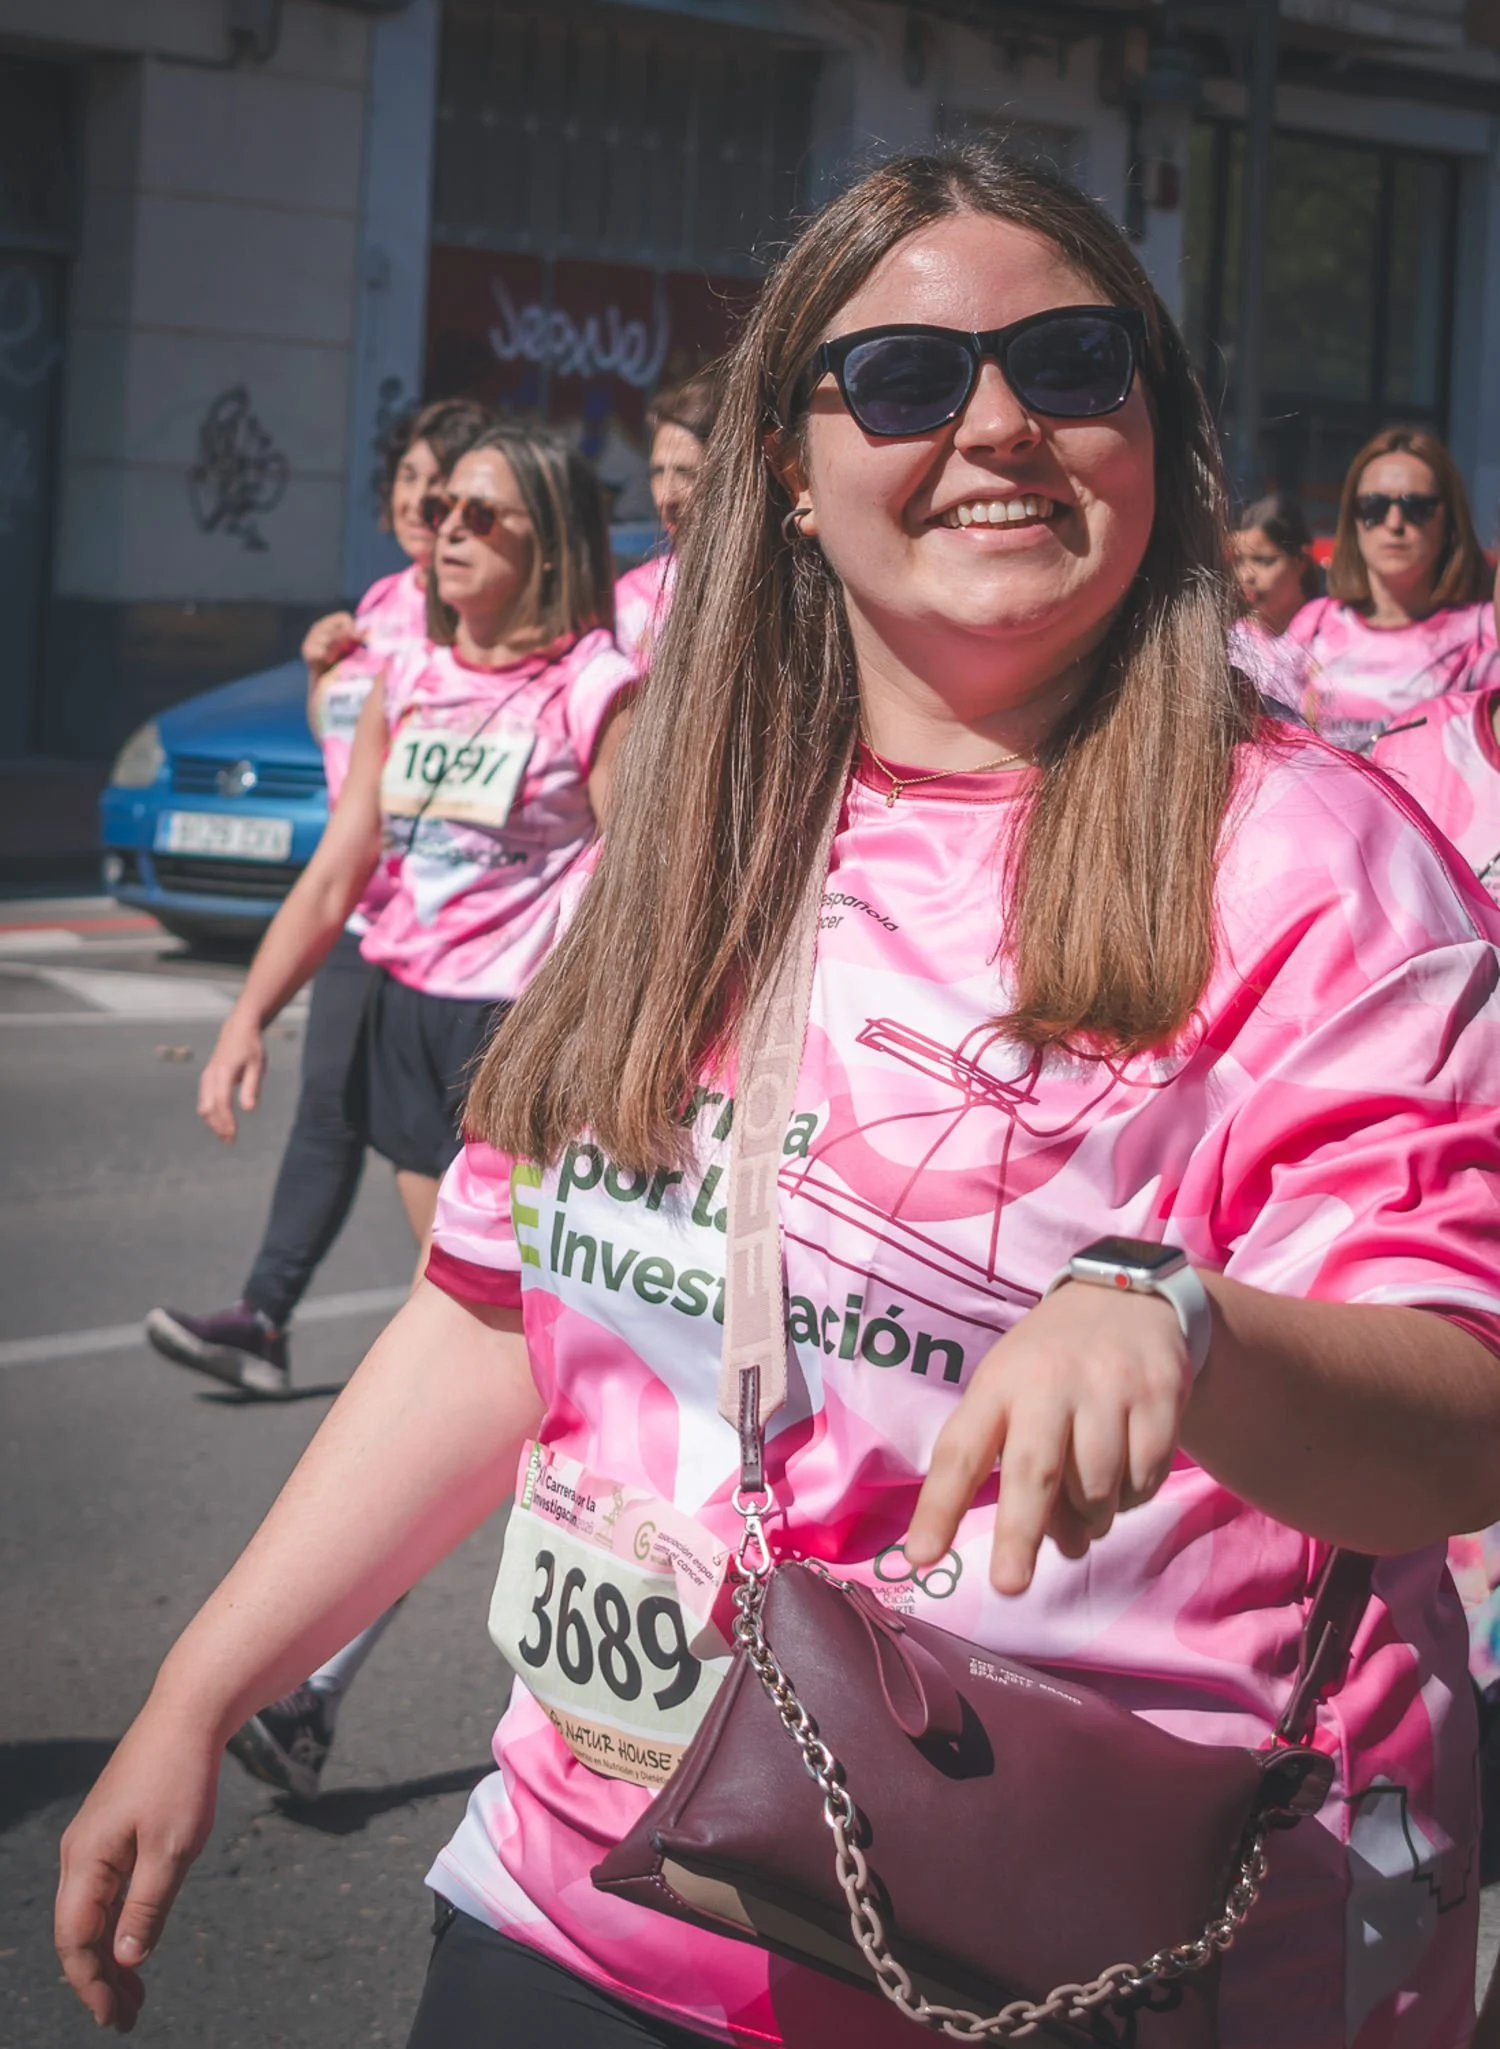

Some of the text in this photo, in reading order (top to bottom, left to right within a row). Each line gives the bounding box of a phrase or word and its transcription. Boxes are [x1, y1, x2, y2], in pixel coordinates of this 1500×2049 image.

[586, 1495, 596, 1513] la
[518, 1549, 702, 1711] 3689
[566, 1720, 672, 1771] NATUR HOUSE
